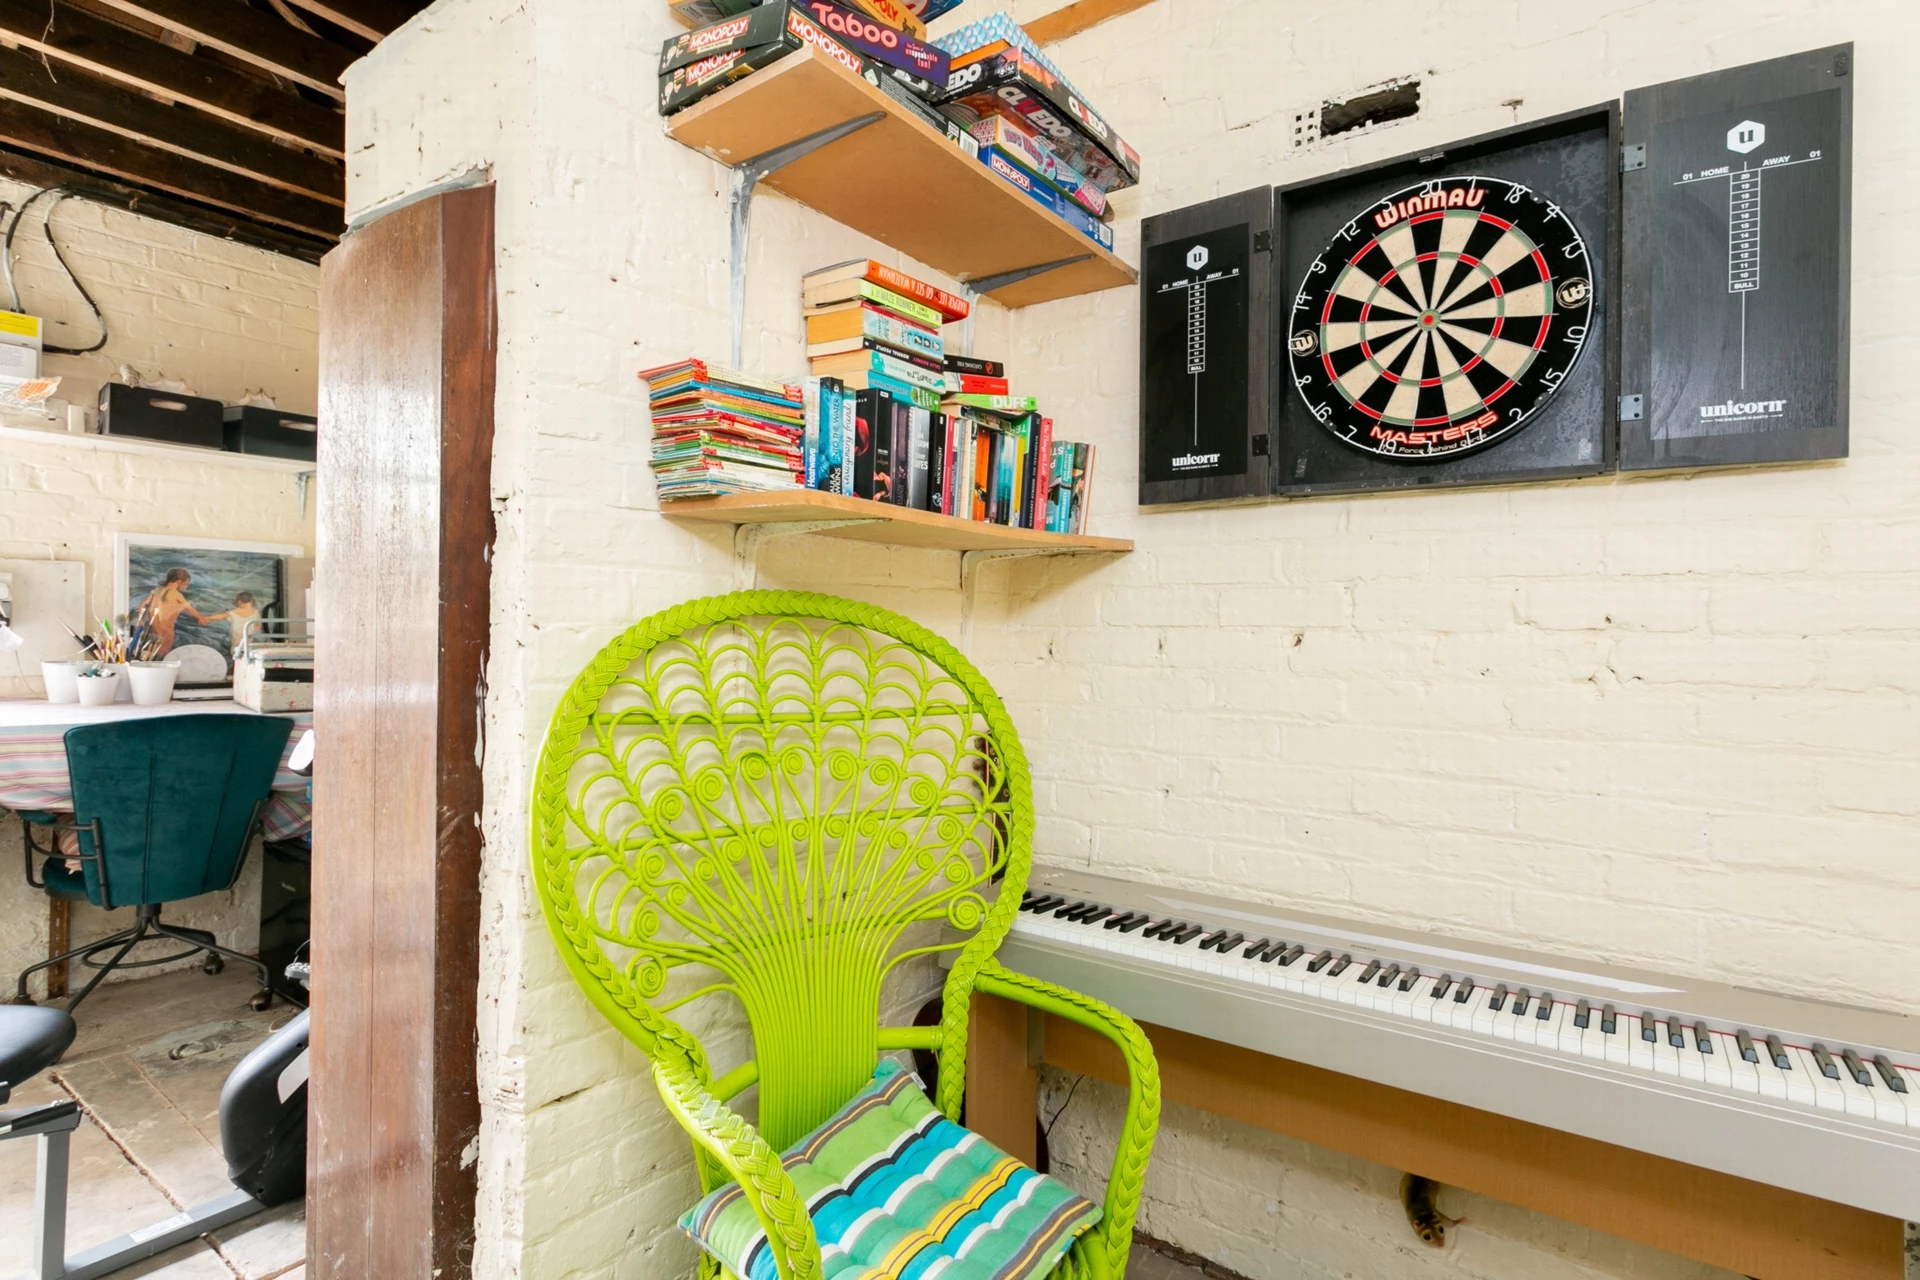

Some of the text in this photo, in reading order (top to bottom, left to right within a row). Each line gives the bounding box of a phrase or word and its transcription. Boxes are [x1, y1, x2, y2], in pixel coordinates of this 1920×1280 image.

[689, 18, 748, 50] MONOPOLY
[811, 3, 897, 48] Taboo
[791, 17, 860, 73] MONOPOLY
[944, 63, 982, 92] EDO
[997, 86, 1072, 137] CLUEDO
[1068, 95, 1108, 138] CLUEDO
[992, 156, 1029, 190] MONOPOLY
[1701, 166, 1729, 178] HOME
[1763, 155, 1791, 166] AWAY
[1810, 150, 1821, 158] 01
[1419, 179, 1441, 198] 20
[1504, 182, 1527, 204] 18
[1375, 187, 1485, 228] WINMAU
[1543, 206, 1560, 223] 4
[1338, 220, 1361, 241] 12
[1310, 260, 1327, 274] 9
[878, 266, 968, 313] HARPER LEE GO SET A WATCHMAN
[1172, 279, 1189, 287] HOME
[1206, 272, 1223, 280] AWAY
[880, 288, 896, 305] MAZE
[896, 294, 916, 313] RUNNER
[1563, 326, 1586, 349] 10
[876, 344, 892, 355] PEOPLE
[891, 349, 910, 360] NORMAL
[912, 356, 928, 366] ROONEY
[1296, 375, 1312, 387] 8
[1540, 368, 1564, 392] 15
[832, 397, 840, 423] WATER
[993, 396, 1028, 409] DUFF
[1311, 401, 1332, 423] 16
[1509, 407, 1523, 421] 2
[1700, 400, 1783, 418] unicorn
[1370, 410, 1499, 445] MASTERS
[843, 403, 854, 485] imaginary friend
[1427, 443, 1457, 453] Behind
[806, 447, 816, 488] Heatwave
[1172, 453, 1218, 467] unicorn
[833, 467, 841, 494] WKINS
